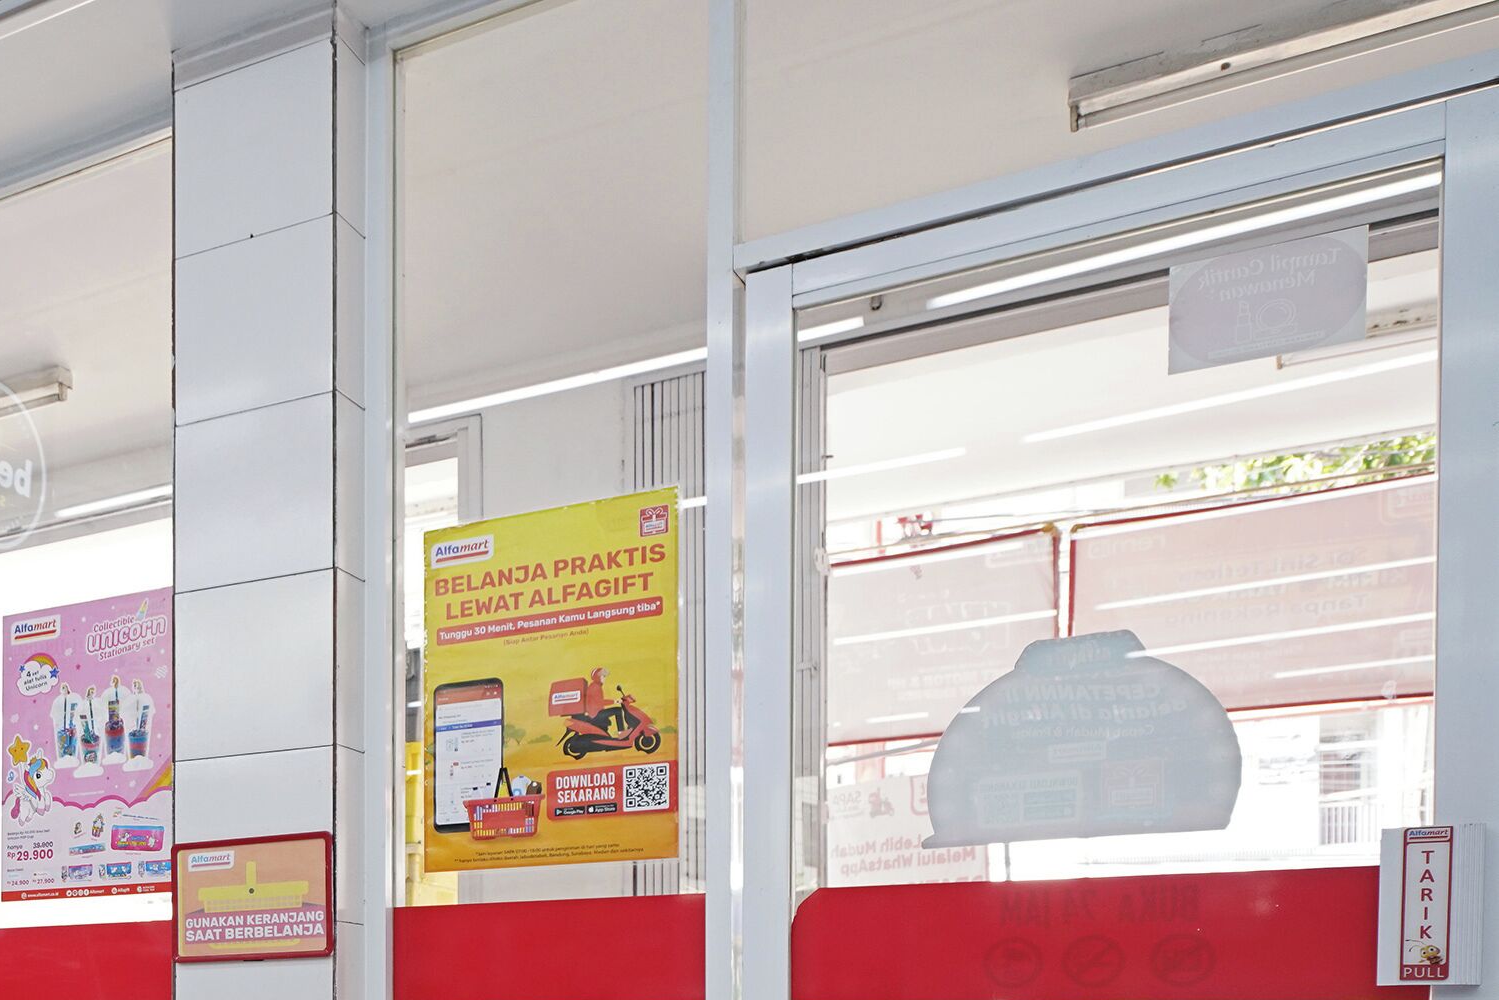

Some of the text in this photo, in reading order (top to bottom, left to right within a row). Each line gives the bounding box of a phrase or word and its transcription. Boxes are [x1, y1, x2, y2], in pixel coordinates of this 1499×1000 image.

[435, 539, 490, 558] Alfamart
[434, 543, 667, 597] BELANJA PRAKTIS
[446, 571, 655, 621] LEWAT ALFAGIFT
[14, 615, 136, 634] Alfamart Collectible
[440, 628, 473, 641] Tunggu
[474, 626, 486, 636] 30
[487, 622, 515, 635] Menit,
[517, 615, 558, 630] Pesanan
[558, 612, 586, 624] Kamu
[587, 605, 636, 622] Langsung
[99, 642, 141, 661] Stationary
[555, 771, 616, 791] DOWNLOAD
[556, 786, 617, 804] SEKARANG
[1408, 828, 1449, 837] Alfamart
[7, 848, 54, 861] Rp 29.900
[191, 853, 231, 865] Alfamart
[1419, 849, 1436, 940] TARIK
[185, 910, 325, 929] GUNAKAN KERANJANG
[185, 923, 325, 942] SAAT BERBELANJA
[1403, 967, 1445, 978] PULL
